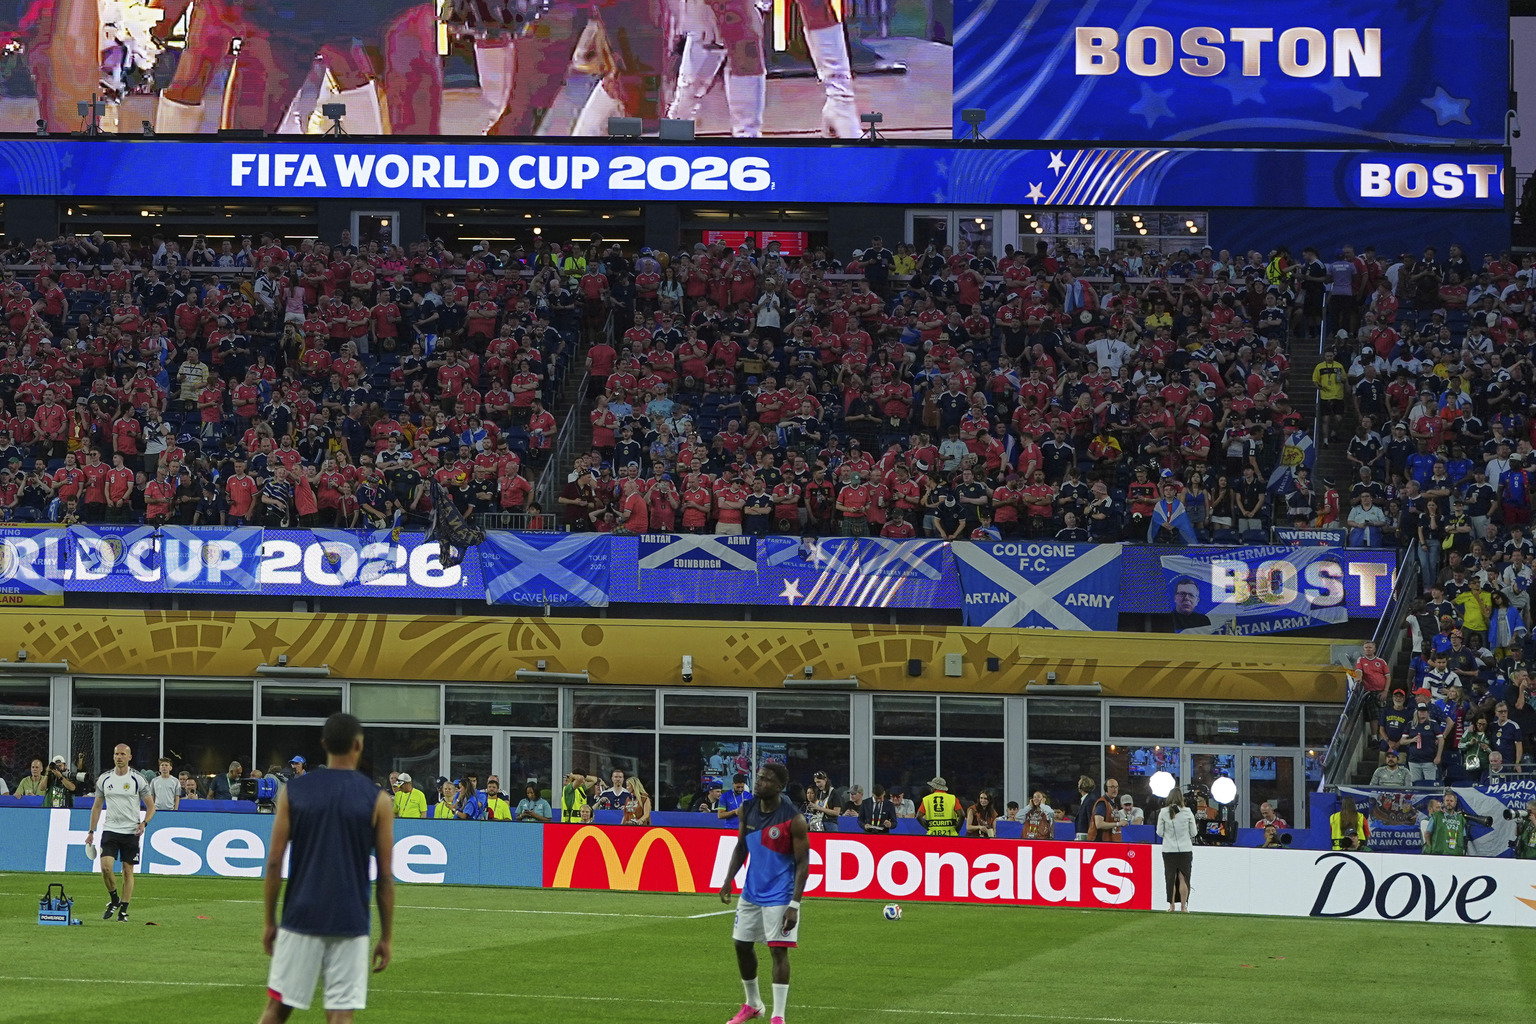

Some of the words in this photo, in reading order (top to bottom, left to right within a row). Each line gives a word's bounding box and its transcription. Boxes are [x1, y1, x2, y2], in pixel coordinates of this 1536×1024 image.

[1075, 25, 1382, 78] BOSTON
[231, 153, 328, 188] FIFA
[334, 153, 500, 190] WORLD
[508, 154, 600, 190] CUP
[608, 156, 771, 192] 2026
[1360, 163, 1504, 199] BOST
[640, 534, 671, 544] TARTAN
[728, 536, 751, 545] ARMY
[1279, 531, 1341, 542] INVERNESS
[482, 552, 500, 560] ORLD
[992, 544, 1075, 558] COLOGNE
[31, 558, 57, 566] ARMY
[126, 537, 244, 583] CUP
[255, 539, 462, 588] 2026
[673, 558, 721, 569] EDINBURGH
[1019, 558, 1050, 572] F.C.
[1211, 559, 1397, 607] BOST
[513, 592, 568, 603] CAVEMEN
[965, 592, 1010, 604] ARTAN
[1064, 593, 1114, 609] ARMY
[1273, 616, 1311, 630] ARMY
[1309, 852, 1497, 924] Dove
